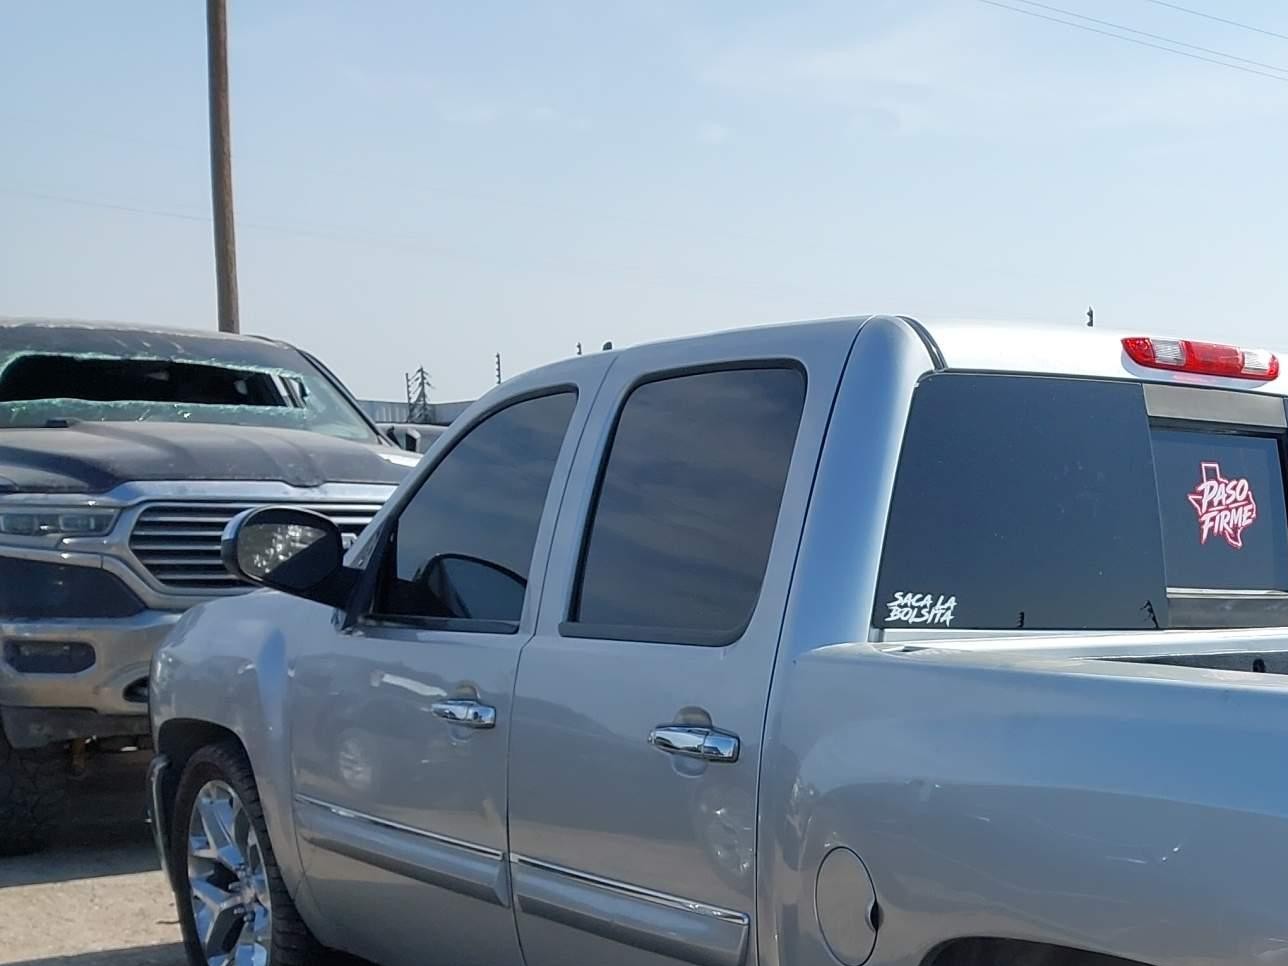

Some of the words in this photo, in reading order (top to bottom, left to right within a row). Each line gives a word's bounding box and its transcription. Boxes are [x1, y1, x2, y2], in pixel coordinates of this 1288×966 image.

[1196, 479, 1249, 513] PASO
[1199, 504, 1254, 544] FIRME
[886, 591, 933, 609] SACA
[935, 595, 957, 611] LA
[884, 606, 955, 627] BOLSITA
